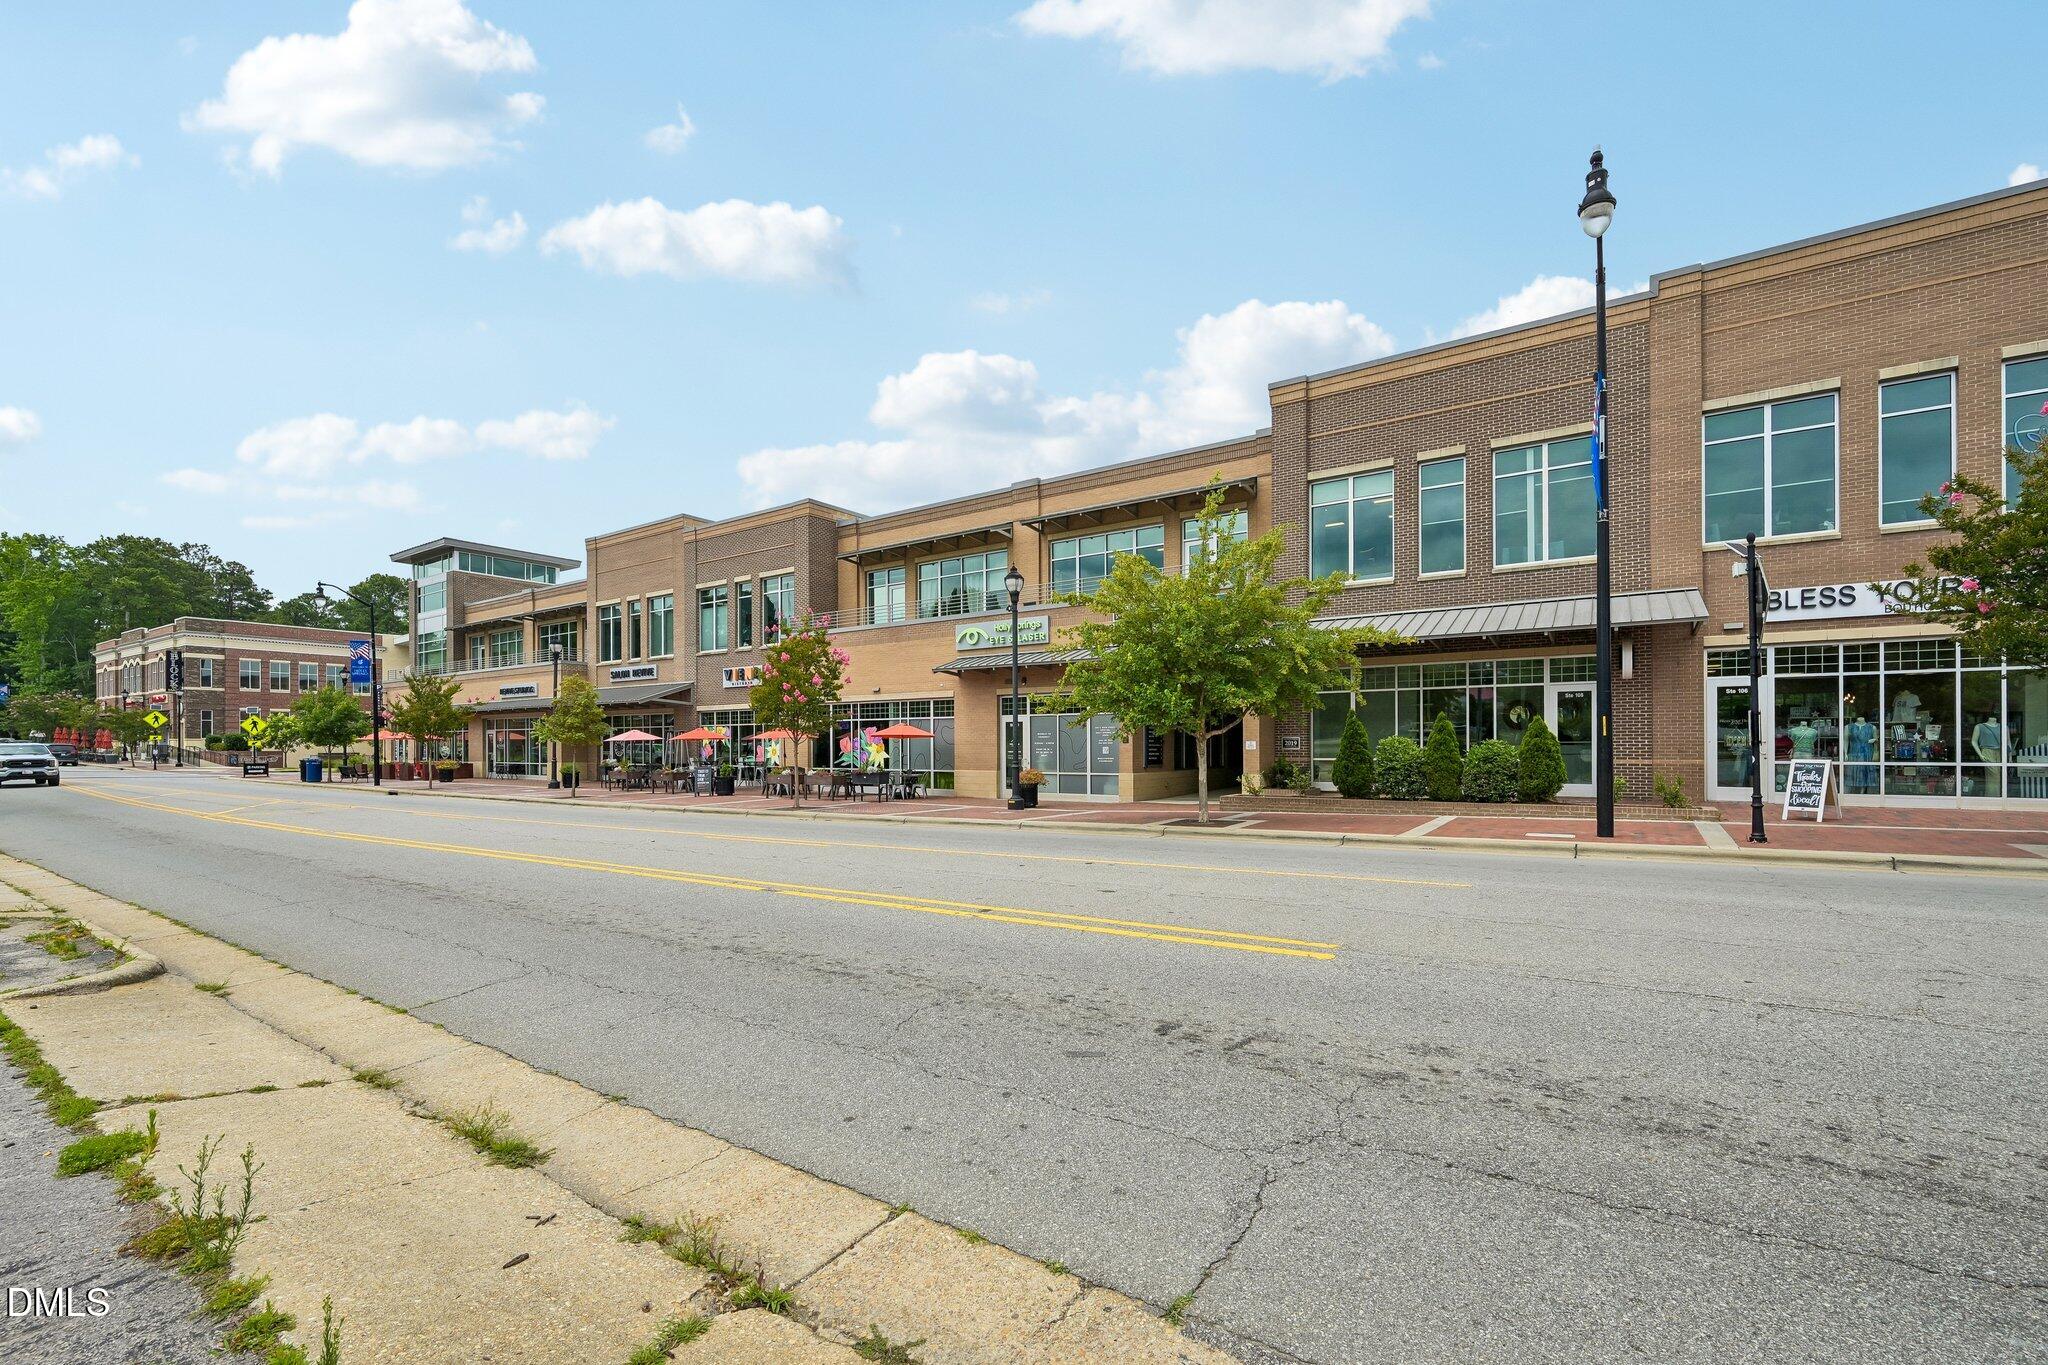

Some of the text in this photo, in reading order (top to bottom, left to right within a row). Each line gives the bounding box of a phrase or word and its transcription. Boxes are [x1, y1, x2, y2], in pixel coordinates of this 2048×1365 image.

[1768, 577, 1963, 612] BLESS YOR
[1884, 603, 1933, 614] BOUTI
[990, 636, 1005, 645] EYE
[1018, 632, 1045, 642] LASER
[1791, 785, 1822, 794] SHOPPING
